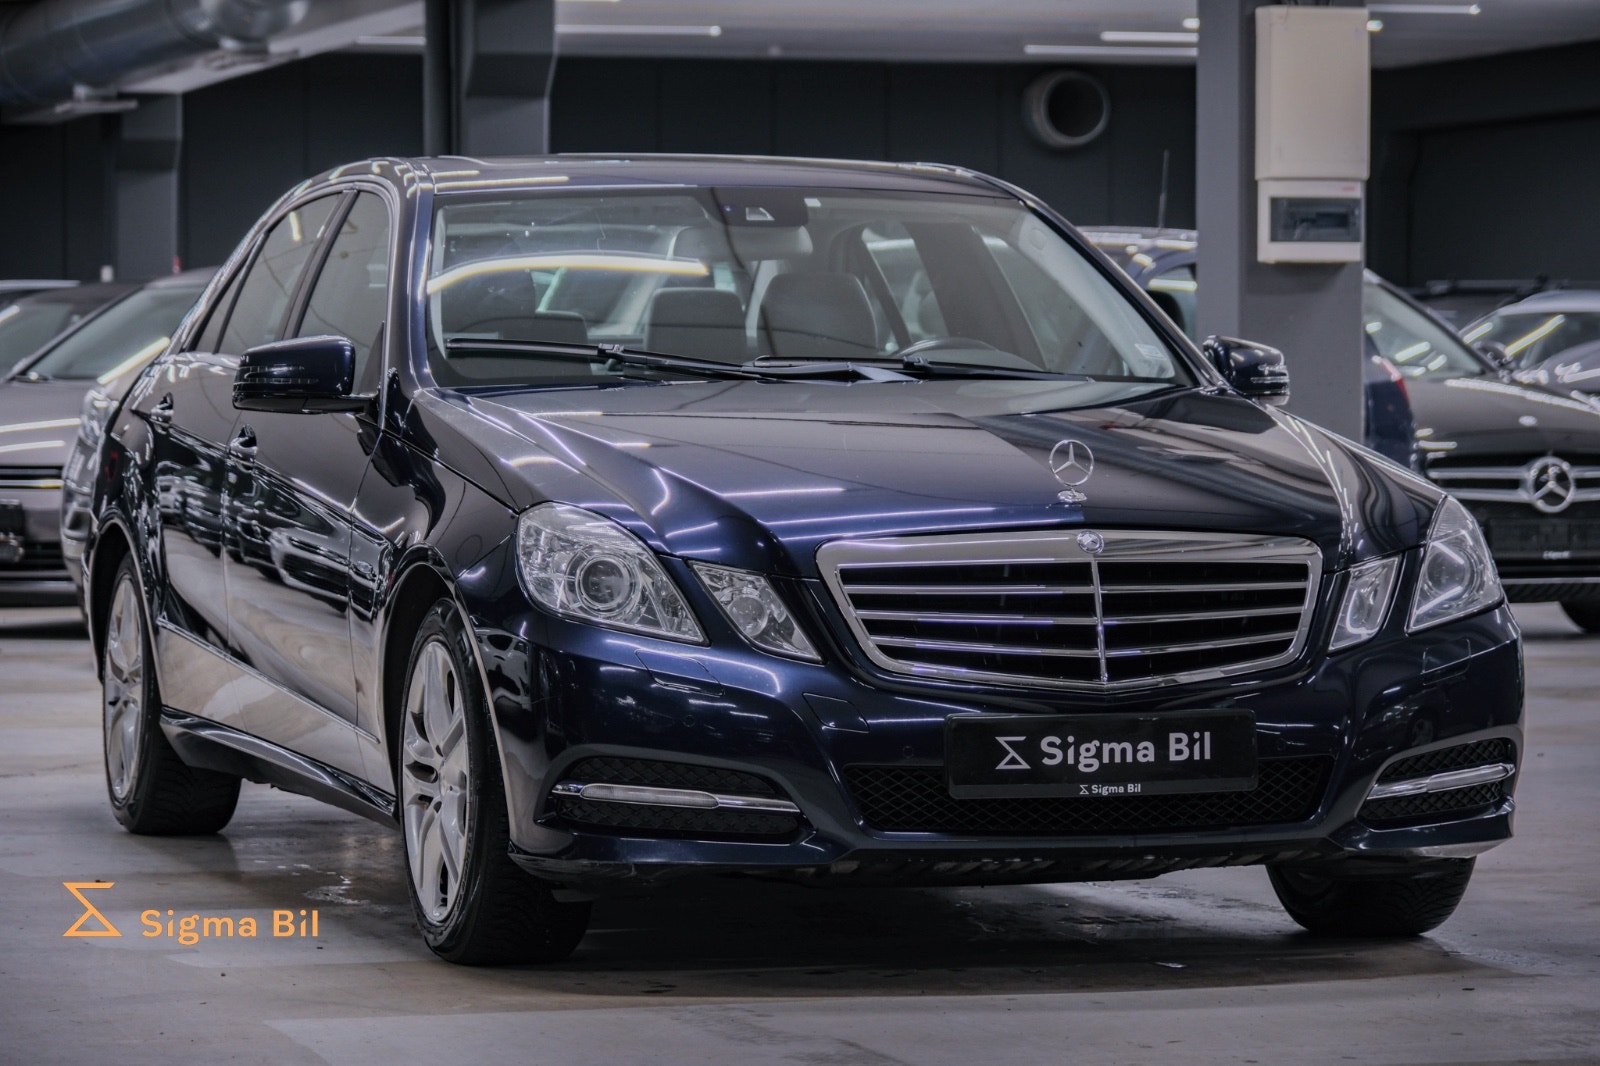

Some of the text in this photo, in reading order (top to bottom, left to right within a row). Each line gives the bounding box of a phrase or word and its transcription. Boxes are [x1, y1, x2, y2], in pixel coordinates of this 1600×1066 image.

[1040, 731, 1211, 773] Sigma Bil
[1091, 783, 1142, 796] Sigma Bil
